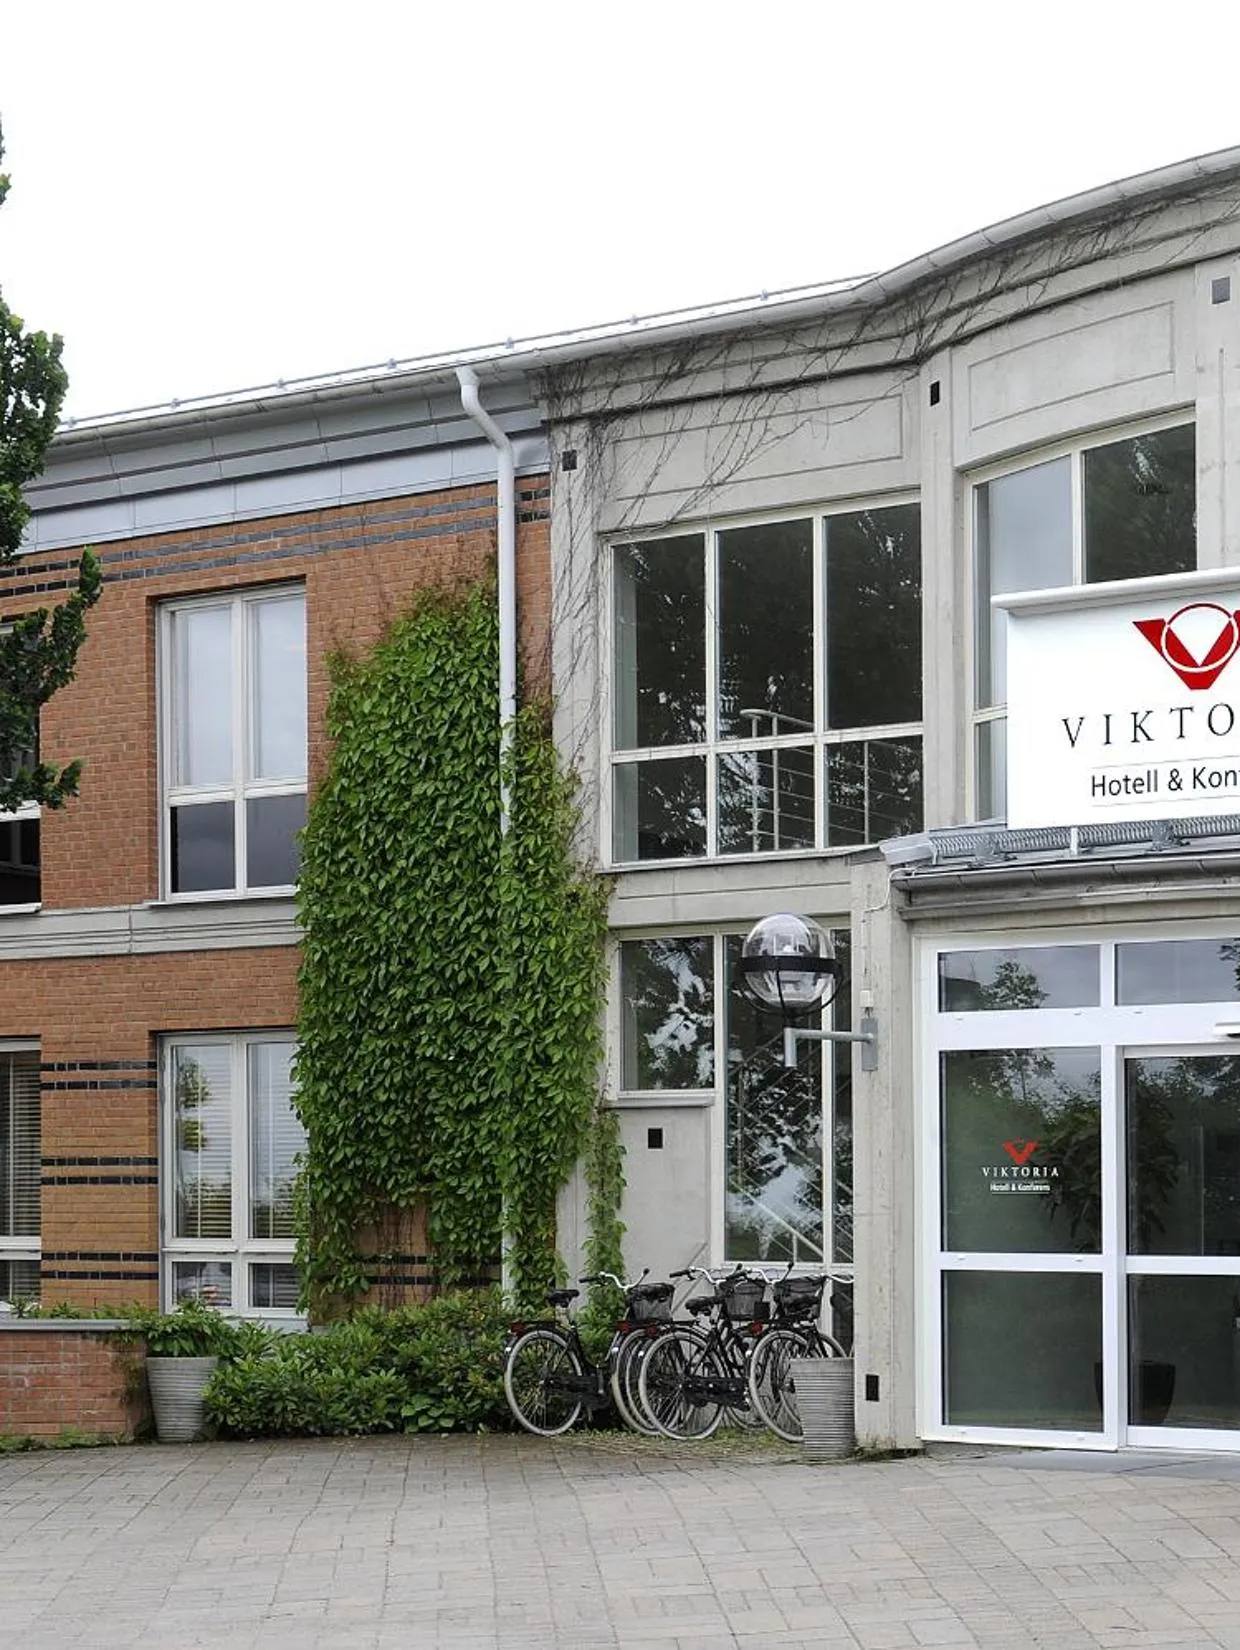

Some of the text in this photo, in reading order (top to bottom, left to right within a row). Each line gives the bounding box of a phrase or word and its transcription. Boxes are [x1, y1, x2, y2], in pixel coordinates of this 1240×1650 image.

[1090, 769, 1159, 798] Hotell
[1167, 769, 1184, 792] &
[982, 1167, 1060, 1177] VIKTORIA
